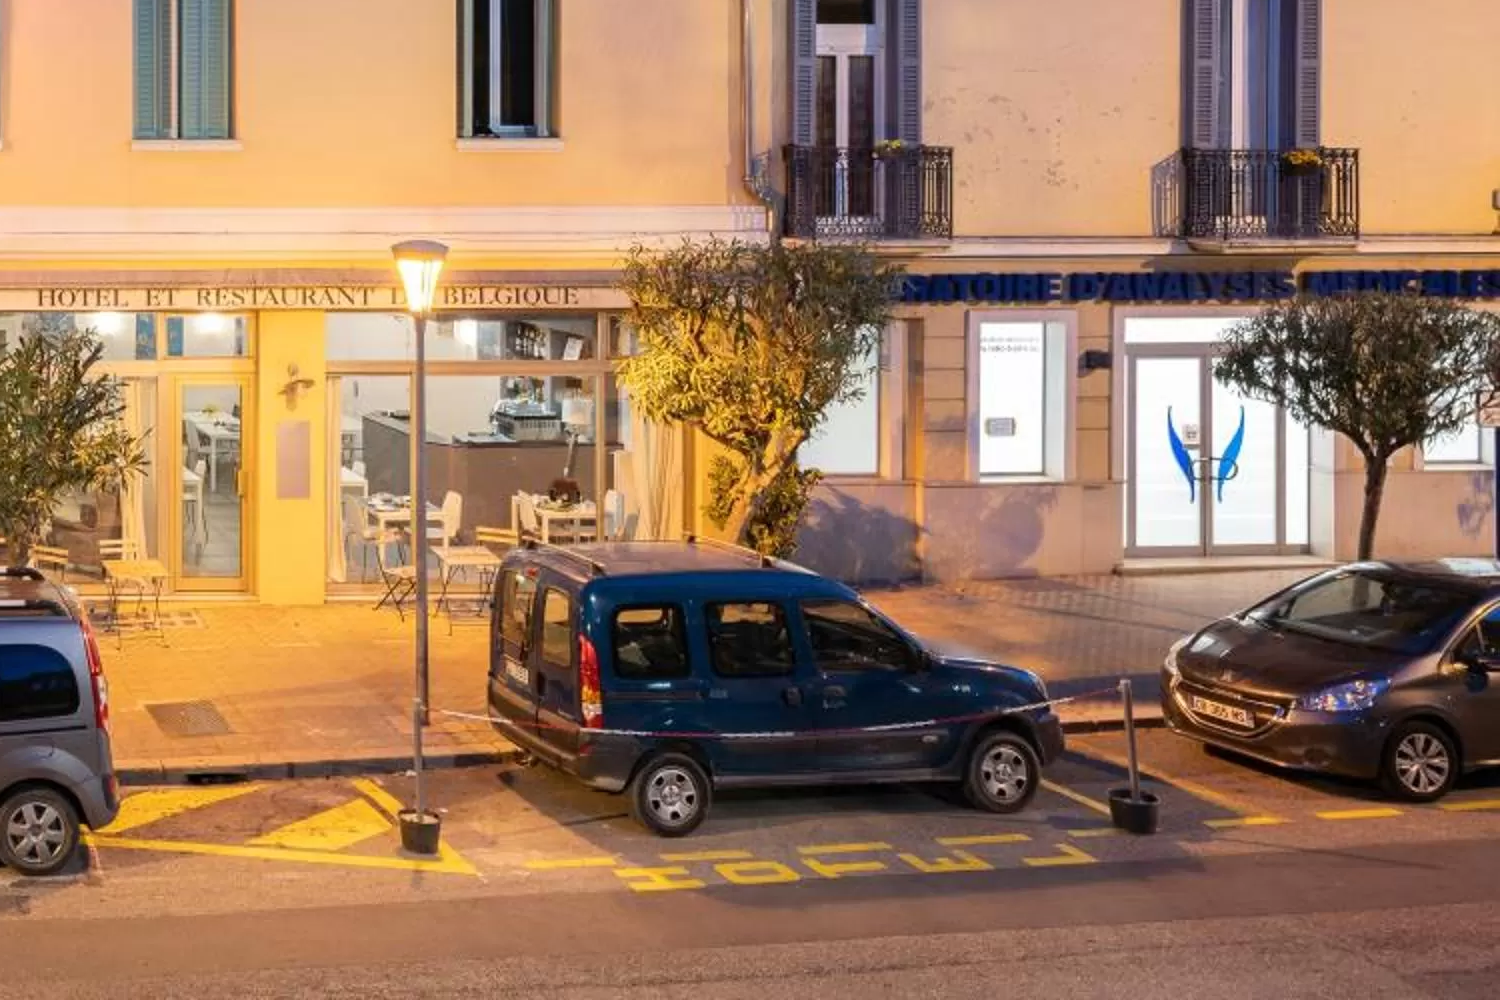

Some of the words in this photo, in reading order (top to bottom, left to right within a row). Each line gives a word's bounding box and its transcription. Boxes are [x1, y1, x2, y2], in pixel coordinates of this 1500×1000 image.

[38, 287, 129, 308] HOTEL
[146, 287, 179, 307] ET
[197, 286, 376, 307] RESTAURANT
[443, 287, 579, 306] BELGIQUE
